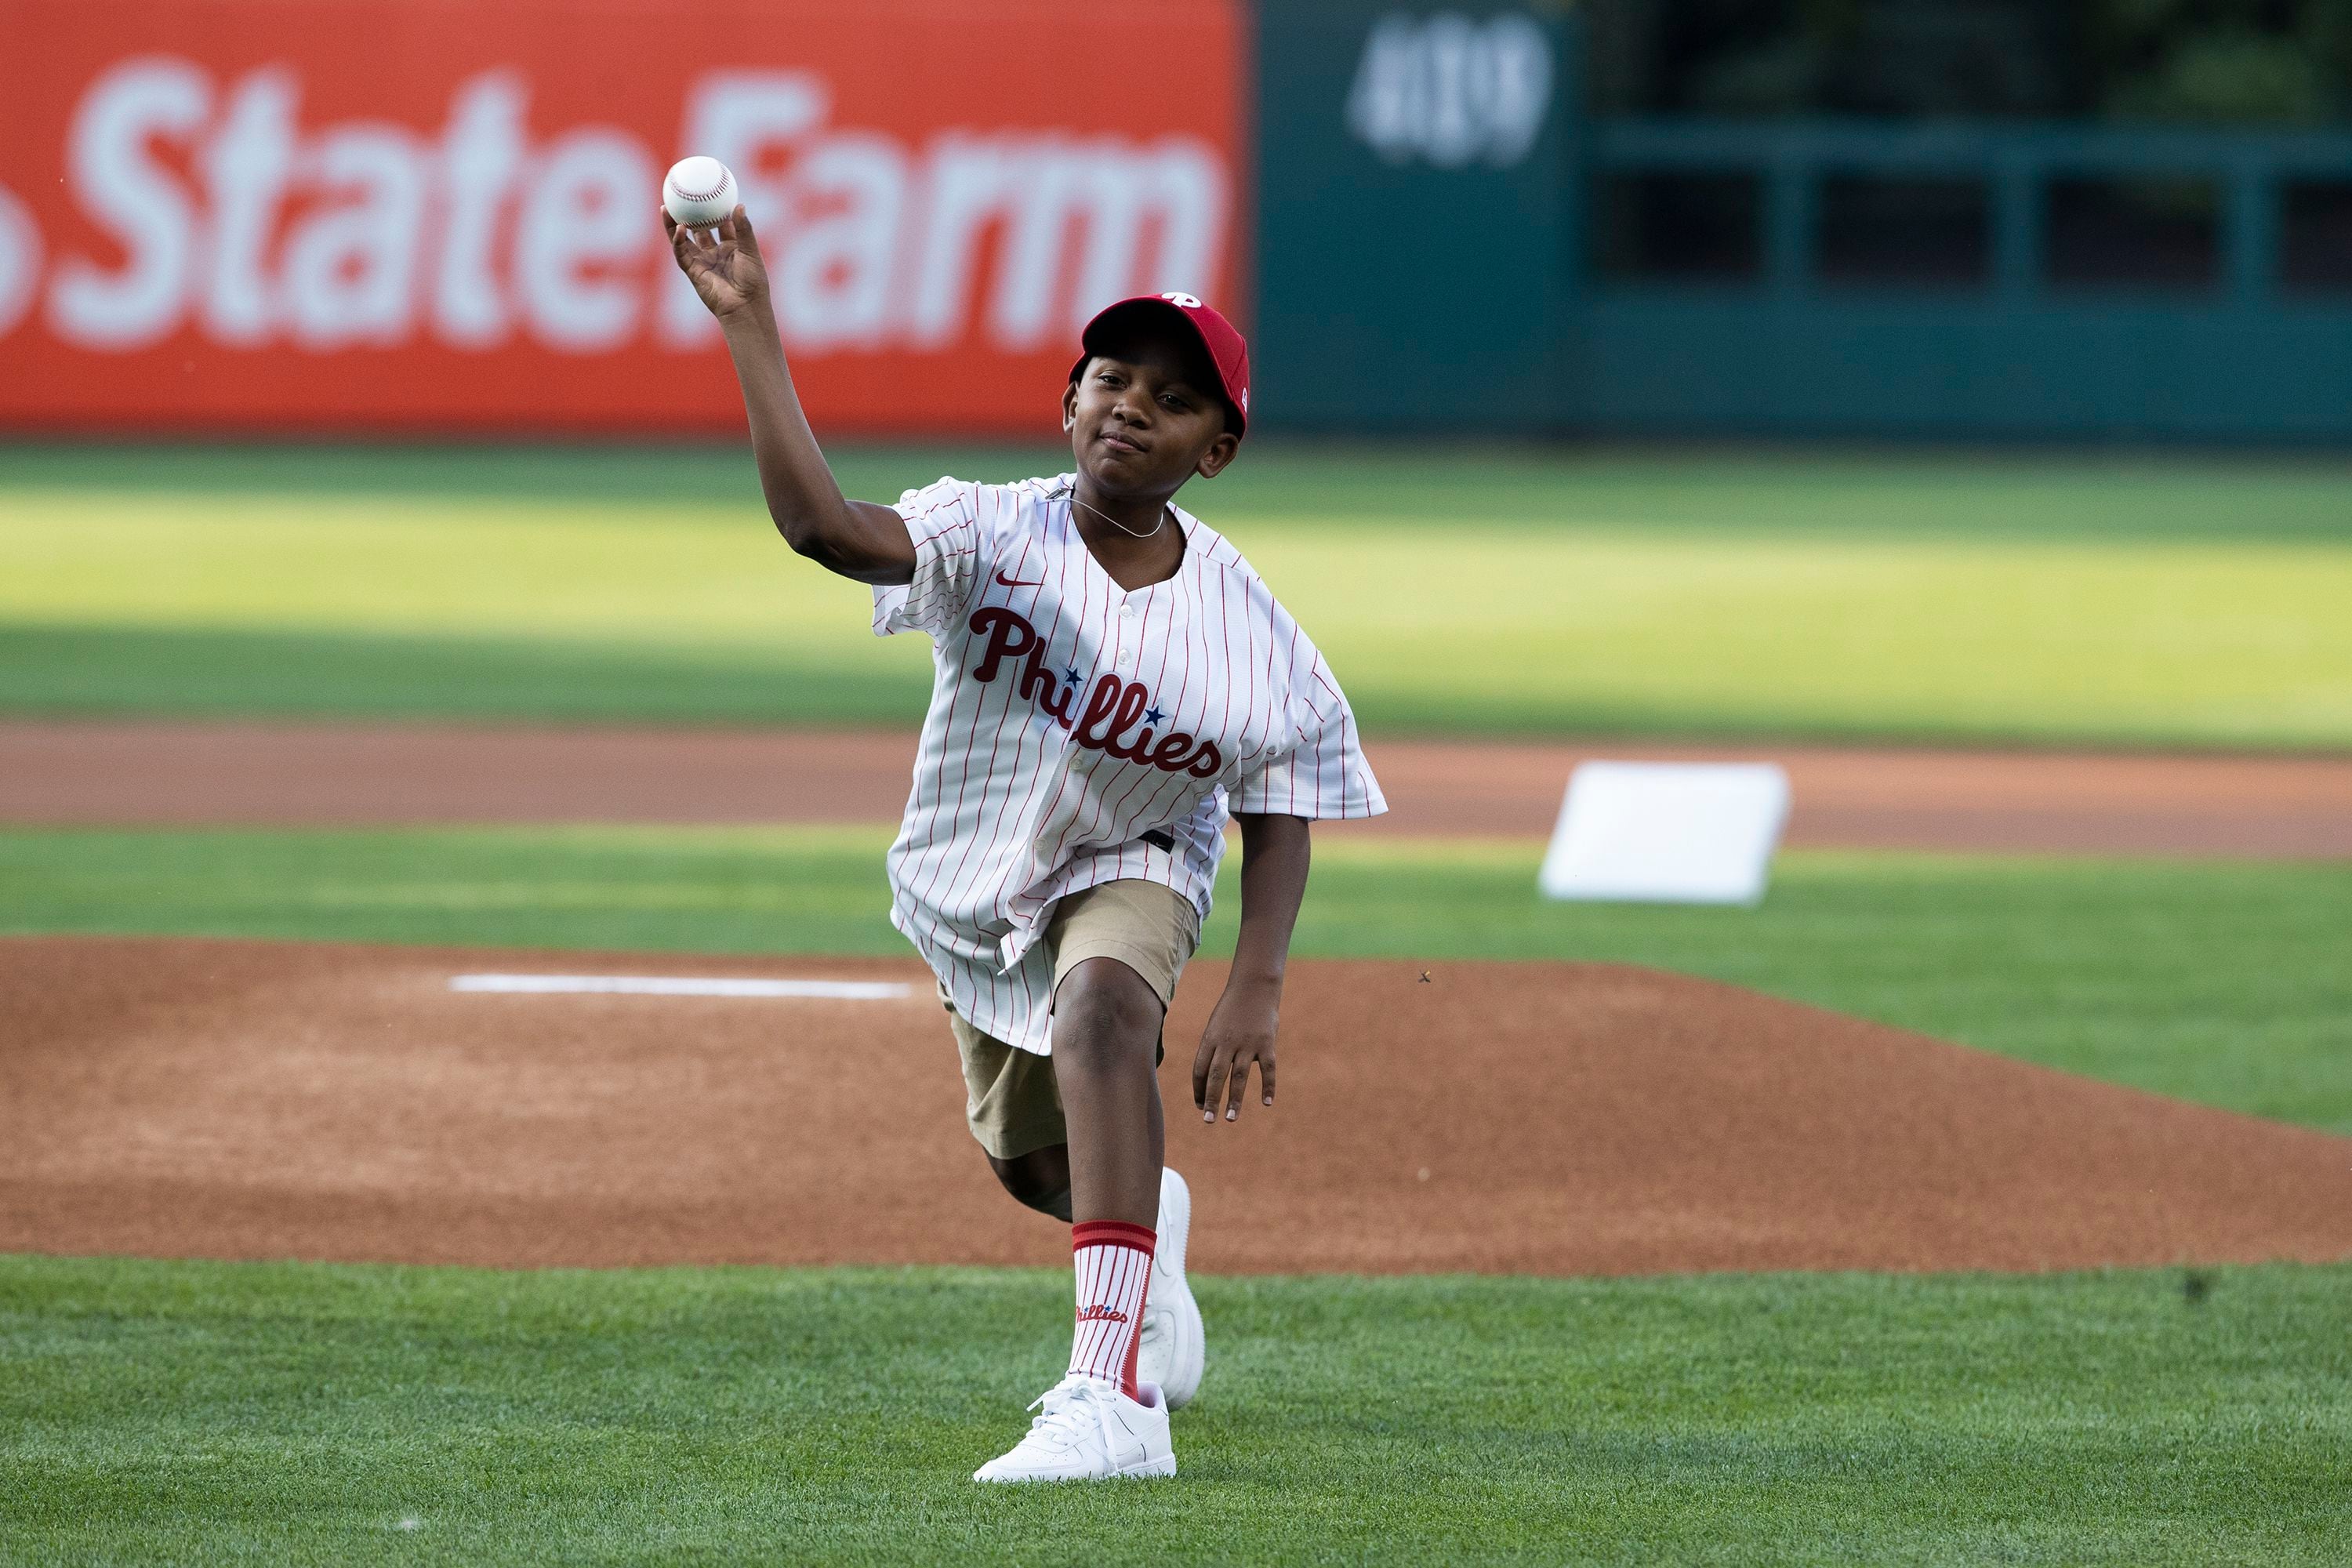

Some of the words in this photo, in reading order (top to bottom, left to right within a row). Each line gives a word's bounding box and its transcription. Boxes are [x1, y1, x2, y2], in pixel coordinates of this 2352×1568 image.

[49, 59, 657, 348] State
[659, 71, 1225, 350] Farm
[968, 606, 1221, 779] Phillies
[1075, 1304, 1128, 1324] hillies
